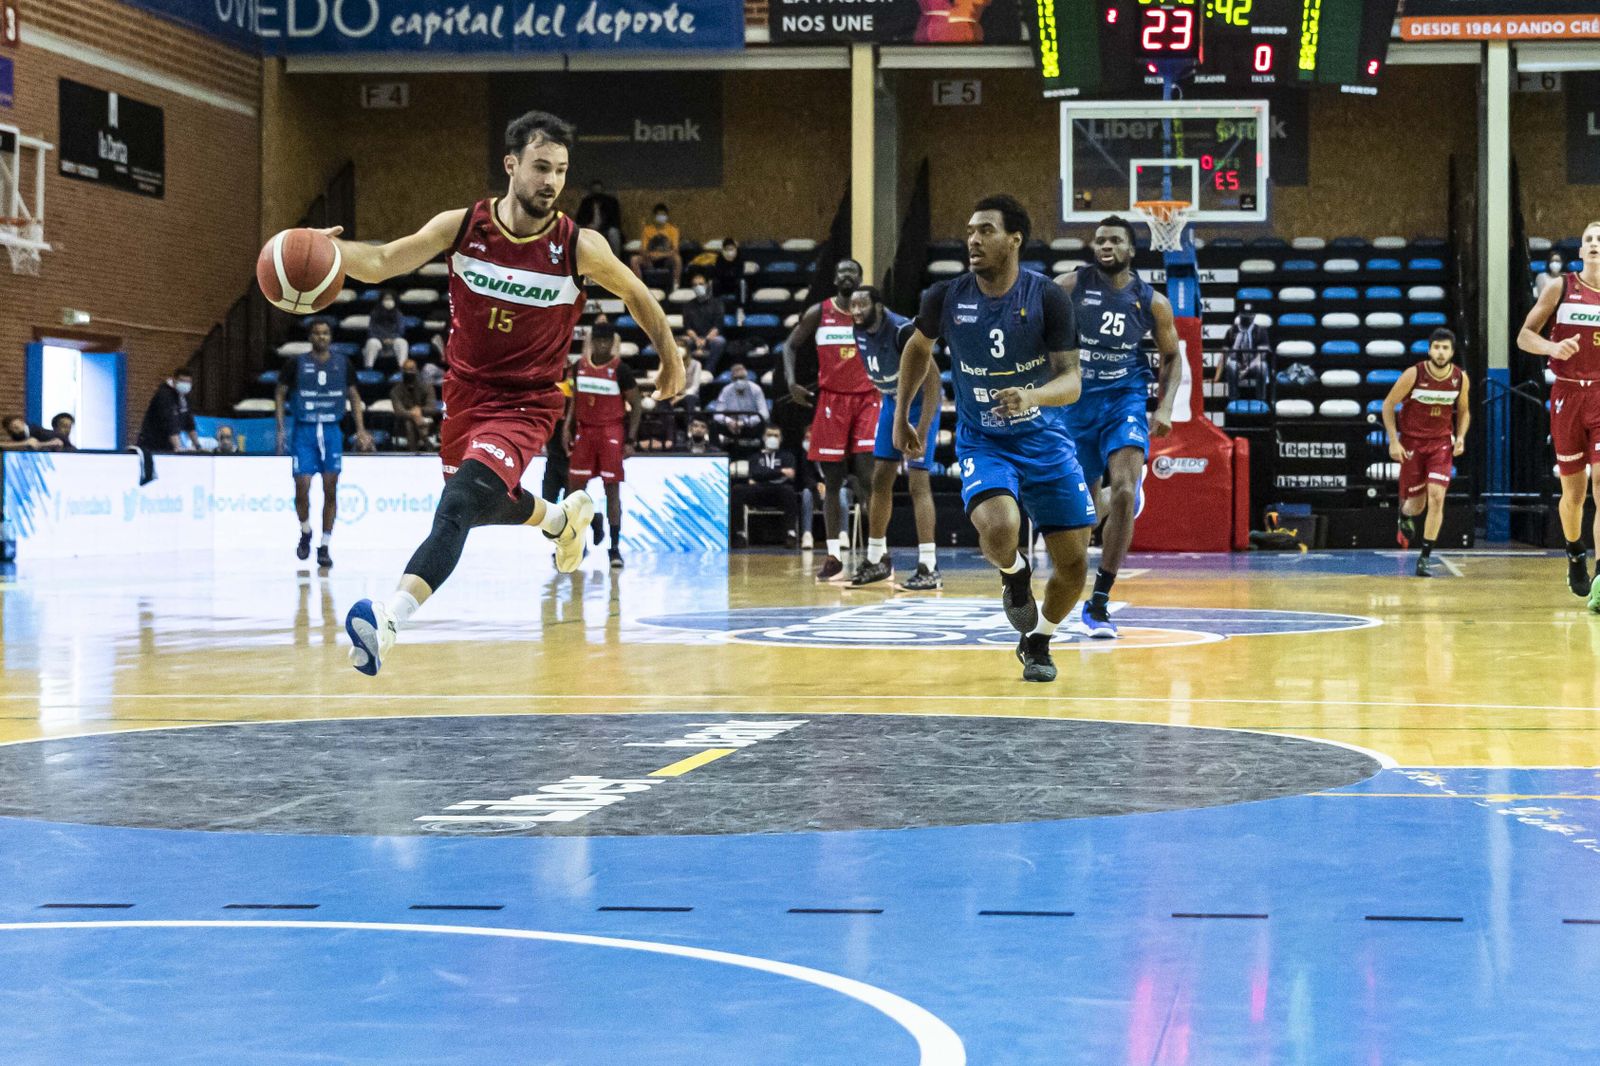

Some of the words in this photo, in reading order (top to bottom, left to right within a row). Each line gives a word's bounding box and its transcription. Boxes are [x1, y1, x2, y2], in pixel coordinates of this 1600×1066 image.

[390, 4, 504, 45] capital
[513, 2, 567, 38] del
[576, 0, 697, 43] deporte
[782, 15, 826, 32] NOS
[832, 14, 874, 32] UNE
[1142, 9, 1193, 50] 23
[1410, 22, 1461, 36] DESDE
[1466, 21, 1501, 35] 1984
[1506, 20, 1566, 35] DANDO
[1254, 45, 1272, 72] 0
[634, 118, 701, 143] bank
[463, 270, 560, 302] COVIRAN
[487, 306, 514, 333] 15
[1100, 310, 1127, 337] 25
[989, 328, 1006, 359] 3
